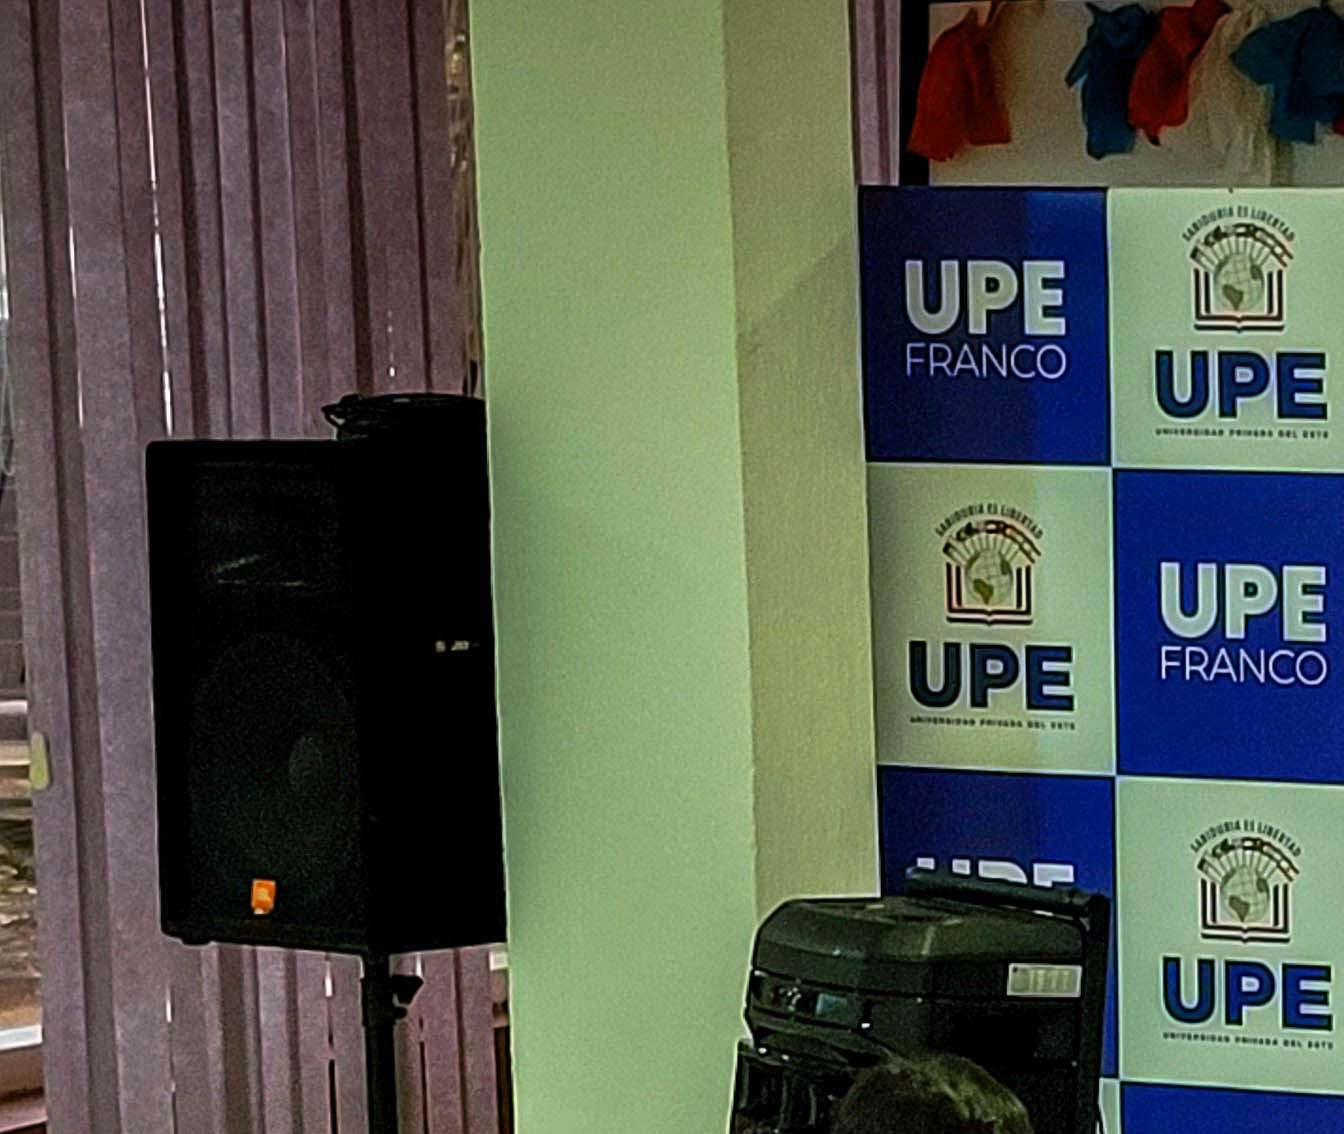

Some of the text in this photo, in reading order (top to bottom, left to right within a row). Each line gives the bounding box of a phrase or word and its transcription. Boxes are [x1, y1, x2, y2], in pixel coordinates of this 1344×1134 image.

[1237, 206, 1249, 218] ES
[905, 259, 1066, 336] UPE
[905, 342, 1067, 380] FRANCO
[1155, 350, 1328, 420] UPE
[1160, 562, 1327, 642] UPE
[908, 640, 1075, 711] UPE
[1160, 645, 1328, 686] FRANCO
[1244, 819, 1255, 832] ES
[1162, 955, 1333, 1031] UPE
